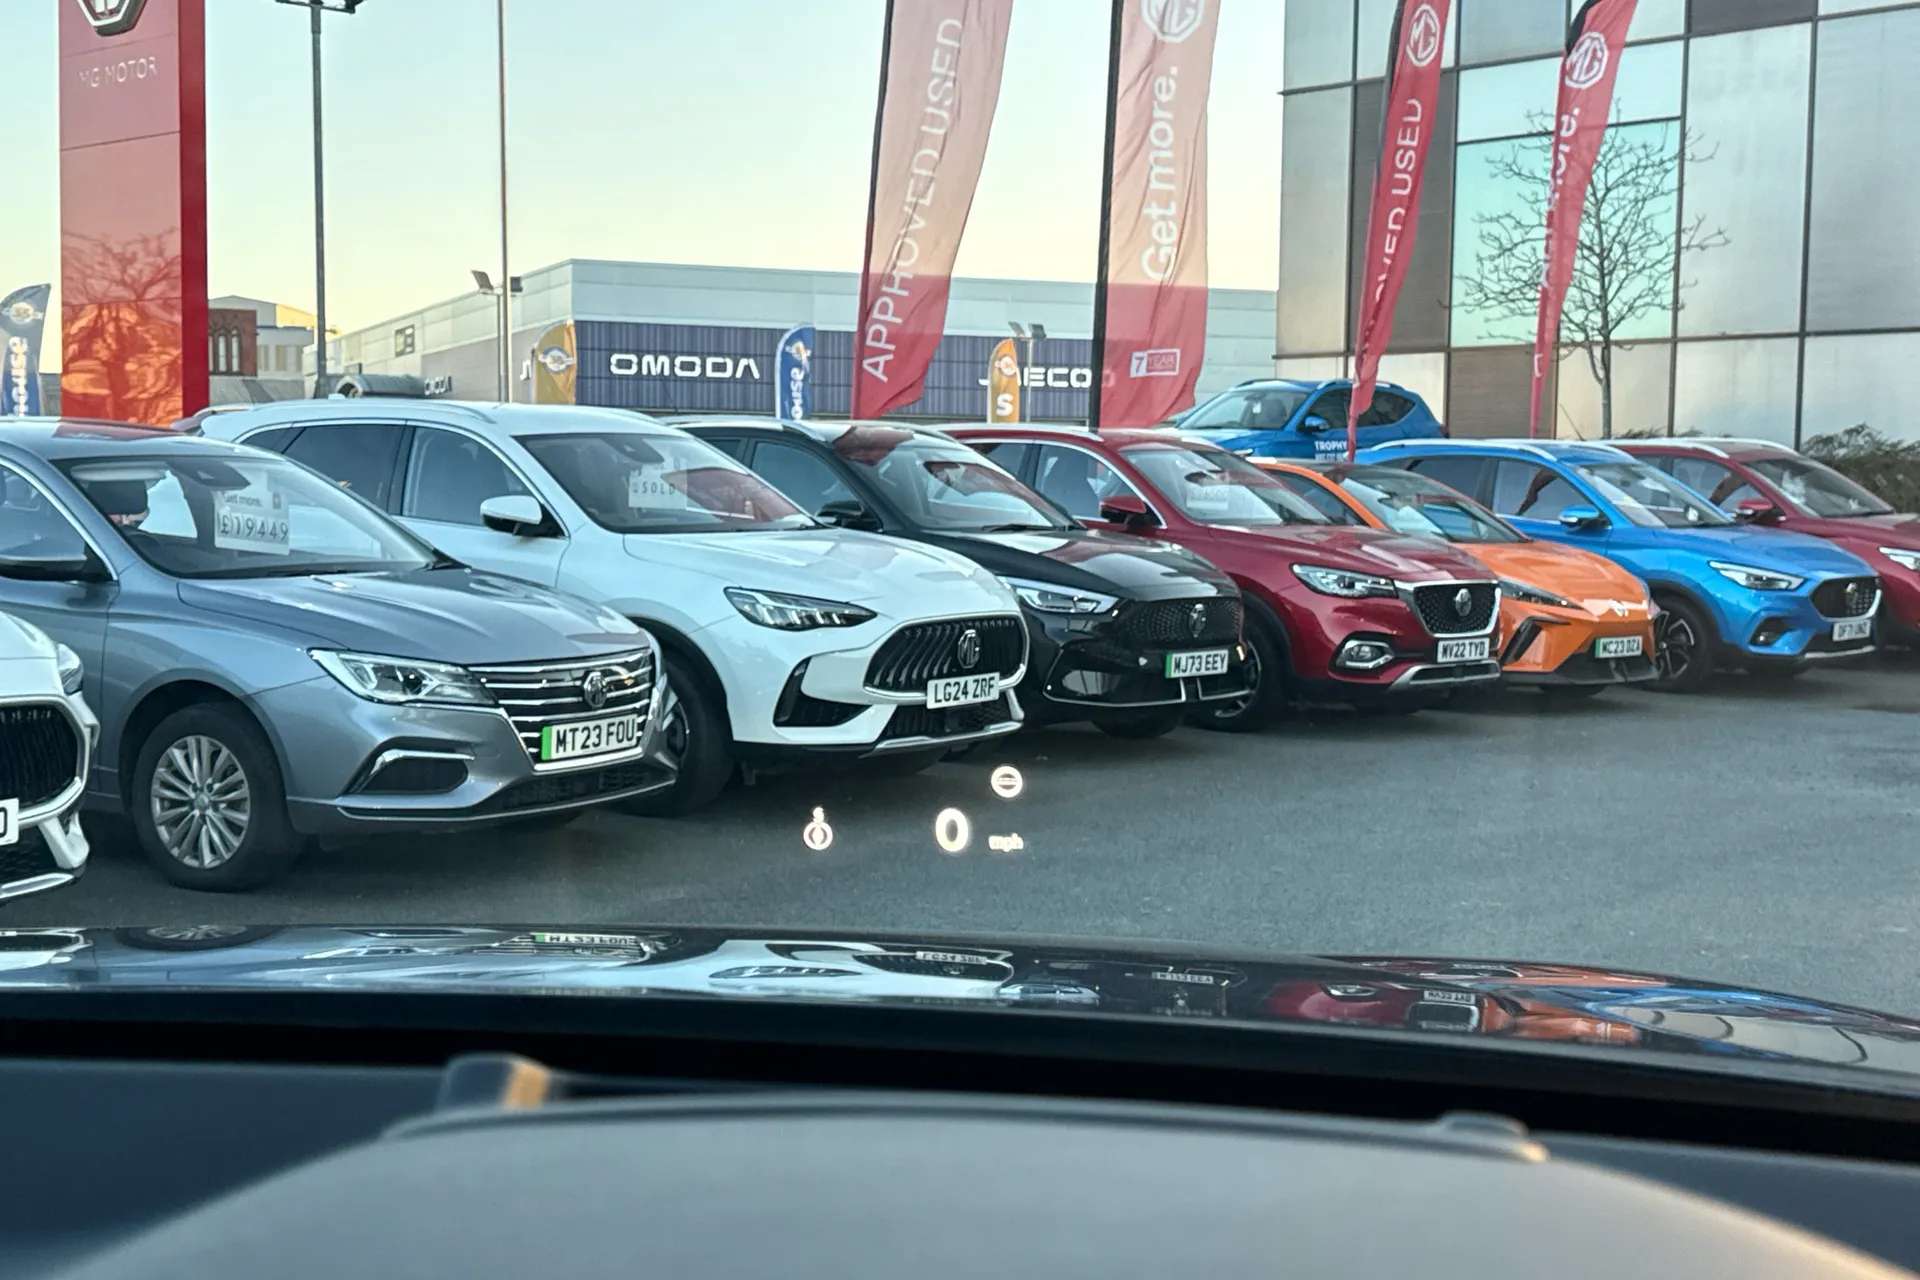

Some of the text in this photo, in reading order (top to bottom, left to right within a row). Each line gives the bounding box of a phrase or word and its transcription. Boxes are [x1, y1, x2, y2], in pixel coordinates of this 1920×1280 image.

[105, 56, 158, 83] MOTOR
[920, 17, 963, 136] USED
[1140, 65, 1179, 281] Get more.
[610, 353, 760, 380] OMODA
[1133, 356, 1145, 374] 7
[1173, 653, 1227, 674] MJ73 EEY
[934, 676, 996, 703] LG24 ZRF
[555, 718, 635, 754] MT23 FOU
[935, 807, 969, 852] 0
